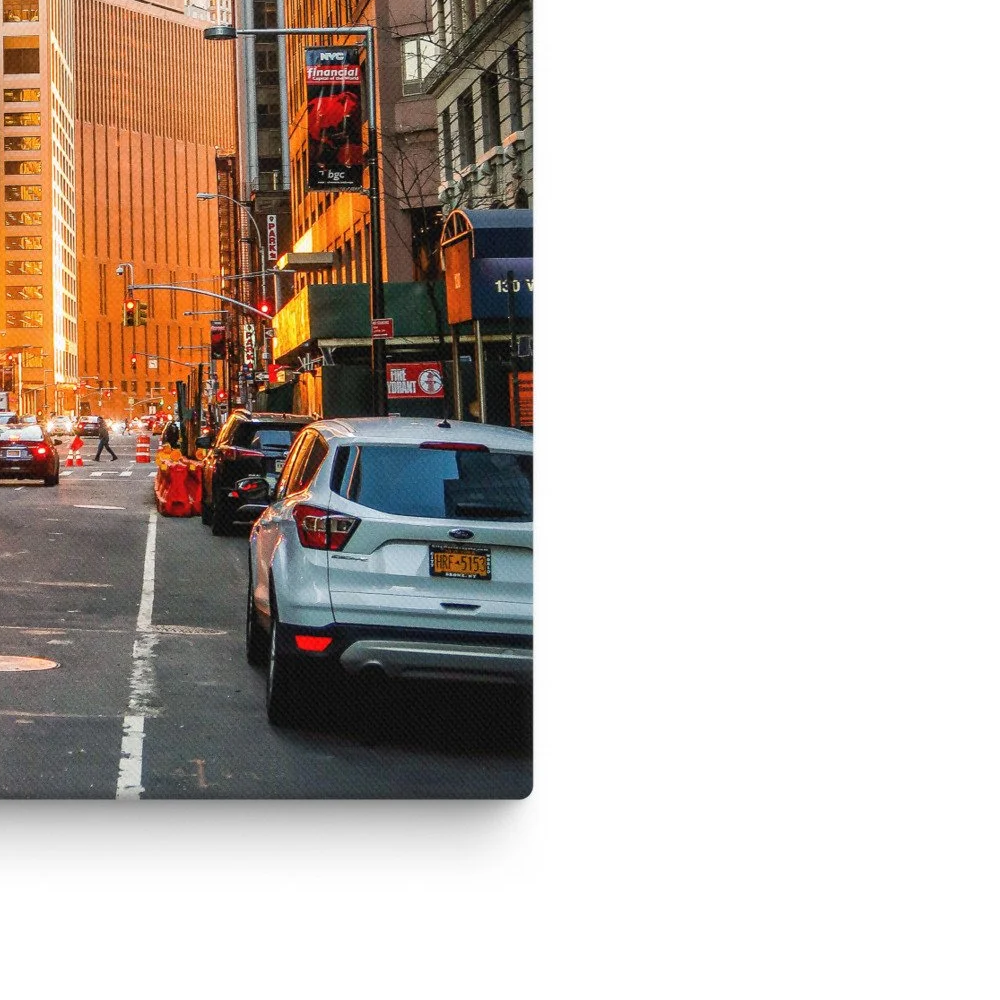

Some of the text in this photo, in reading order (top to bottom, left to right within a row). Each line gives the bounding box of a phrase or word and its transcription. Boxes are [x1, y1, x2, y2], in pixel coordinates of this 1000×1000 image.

[320, 52, 344, 60] NYC
[307, 67, 359, 79] financial
[327, 169, 346, 181] bgc
[268, 223, 276, 252] PARK
[246, 332, 254, 360] PARK
[387, 381, 417, 394] YDRANT
